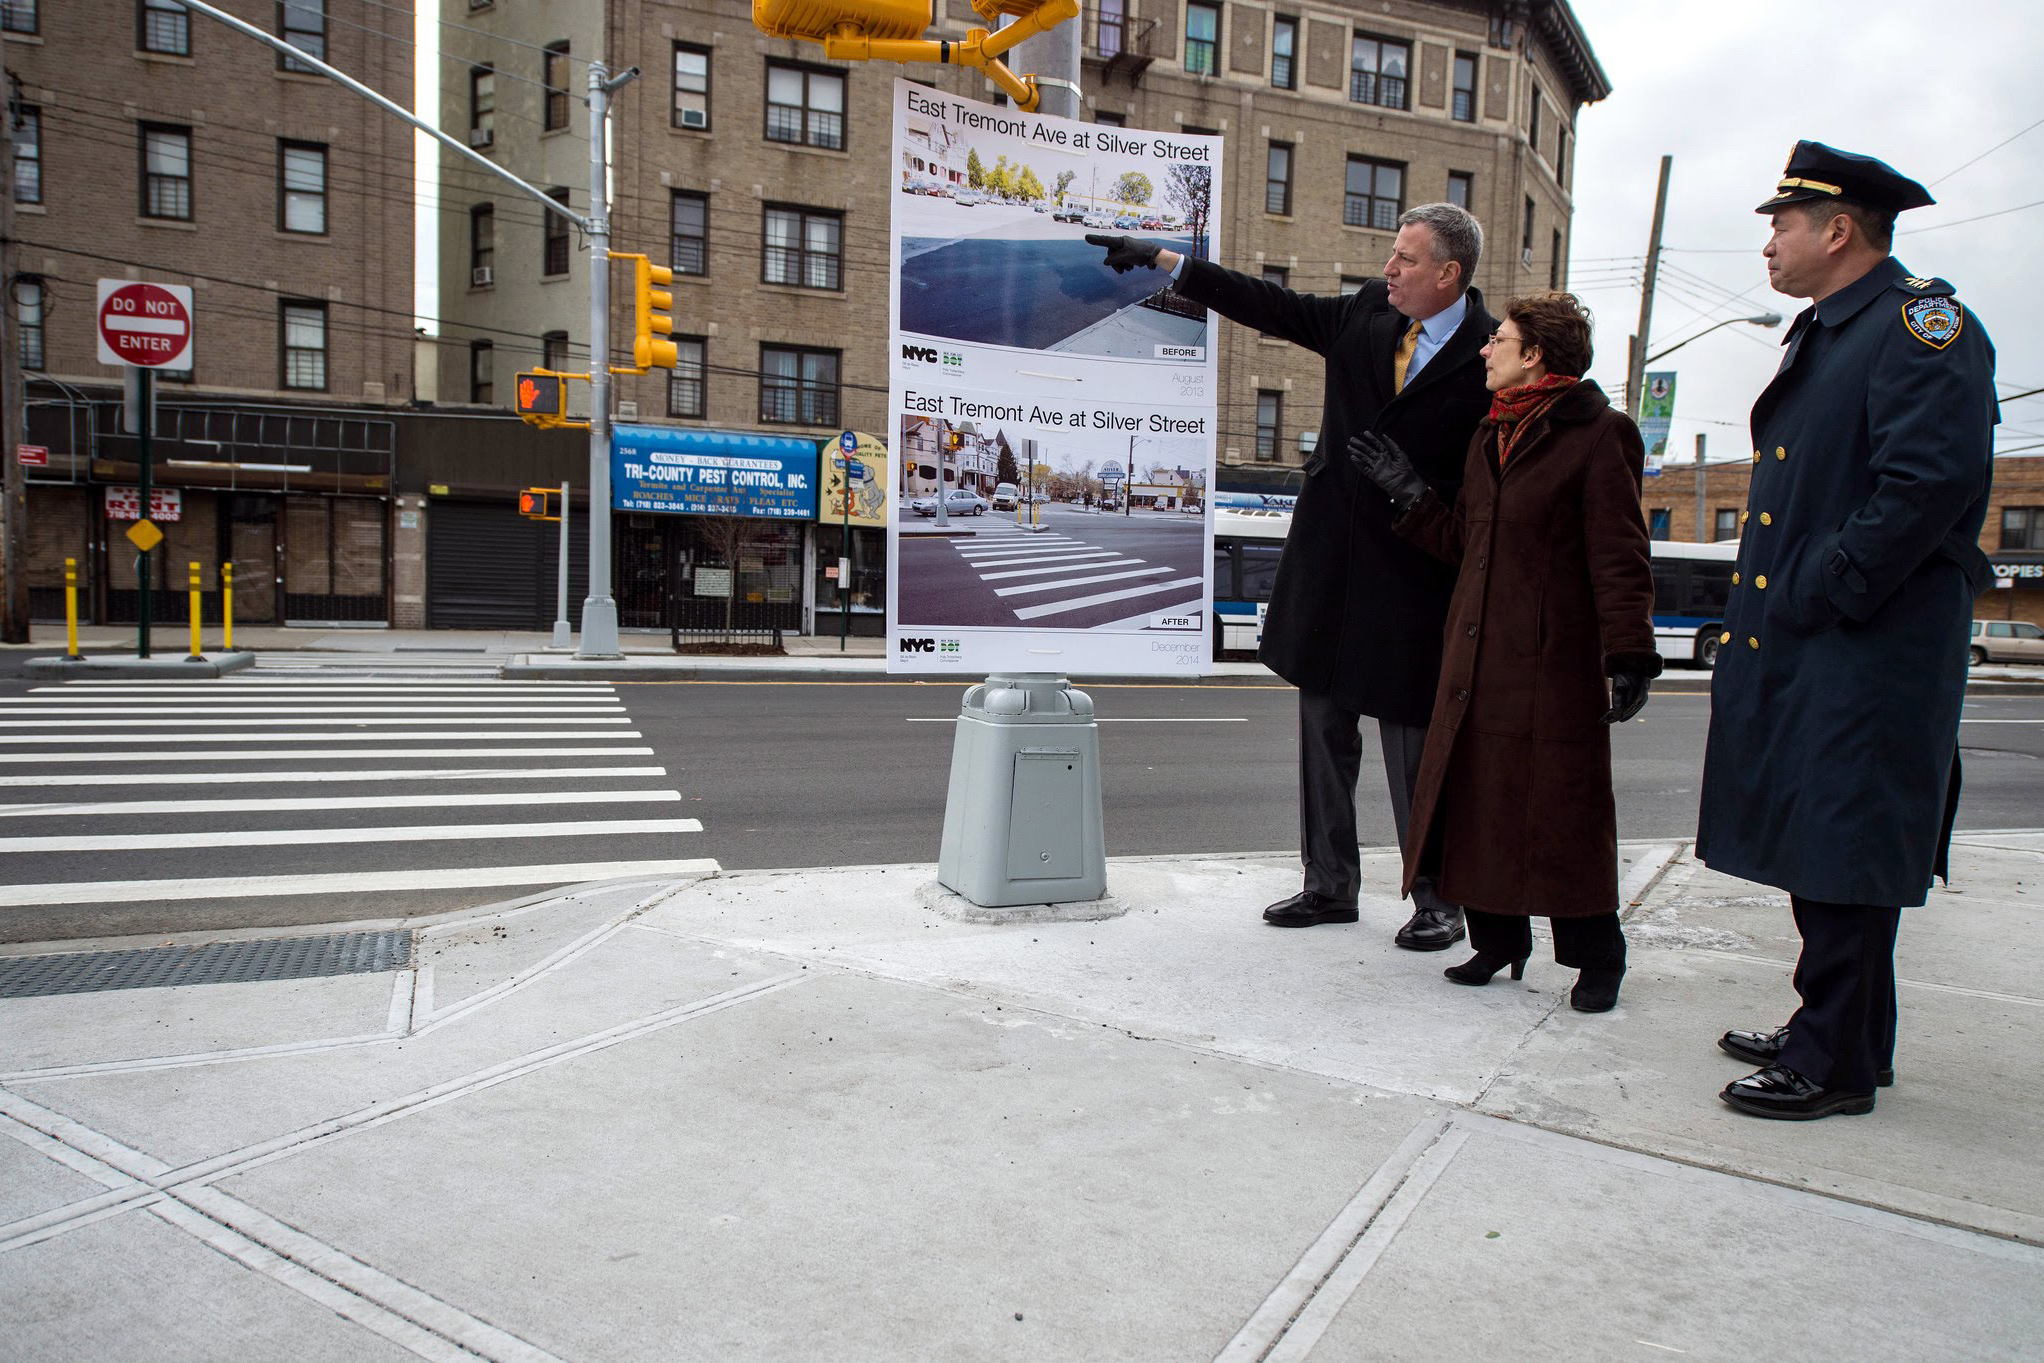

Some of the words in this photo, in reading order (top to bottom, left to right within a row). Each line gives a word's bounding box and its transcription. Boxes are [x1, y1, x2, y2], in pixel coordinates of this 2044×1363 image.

[908, 90, 946, 120] East
[952, 103, 1026, 138] Tremont
[1032, 122, 1066, 144] Ave
[1073, 132, 1090, 148] at
[1096, 133, 1147, 156] Silver
[1153, 140, 1210, 161] Street
[112, 297, 136, 312] DO
[146, 300, 176, 315] NOT
[1908, 302, 1958, 315] DEPARTMENT
[1910, 320, 1924, 333] CITY
[1942, 330, 1955, 340] NEW
[120, 335, 171, 352] ENTER
[902, 344, 938, 364] NYC
[1162, 348, 1196, 356] BEFORE
[1172, 372, 1204, 385] August
[1180, 386, 1204, 396] 2013
[904, 390, 943, 413] East
[950, 396, 1024, 422] Tremont
[1029, 406, 1063, 425] Ave
[1069, 410, 1086, 428] at
[1092, 410, 1143, 430] Silver
[1149, 414, 1205, 434] Street
[655, 454, 686, 464] MONEY
[698, 457, 718, 466] BACK
[720, 458, 778, 469] GUARANTEES
[624, 463, 694, 482] TRI-COUNTY
[699, 468, 727, 484] PEST
[732, 470, 784, 489] CONTROL,
[788, 474, 808, 488] INC.
[639, 480, 668, 489] Termite
[690, 484, 728, 493] Carpenter
[760, 488, 794, 496] Specialist
[633, 492, 674, 500] ROACHES
[685, 494, 706, 502] MICE
[109, 501, 178, 511] RENT
[900, 638, 935, 652] NYC
[1152, 642, 1200, 652] December
[1176, 655, 1199, 665] 2014
